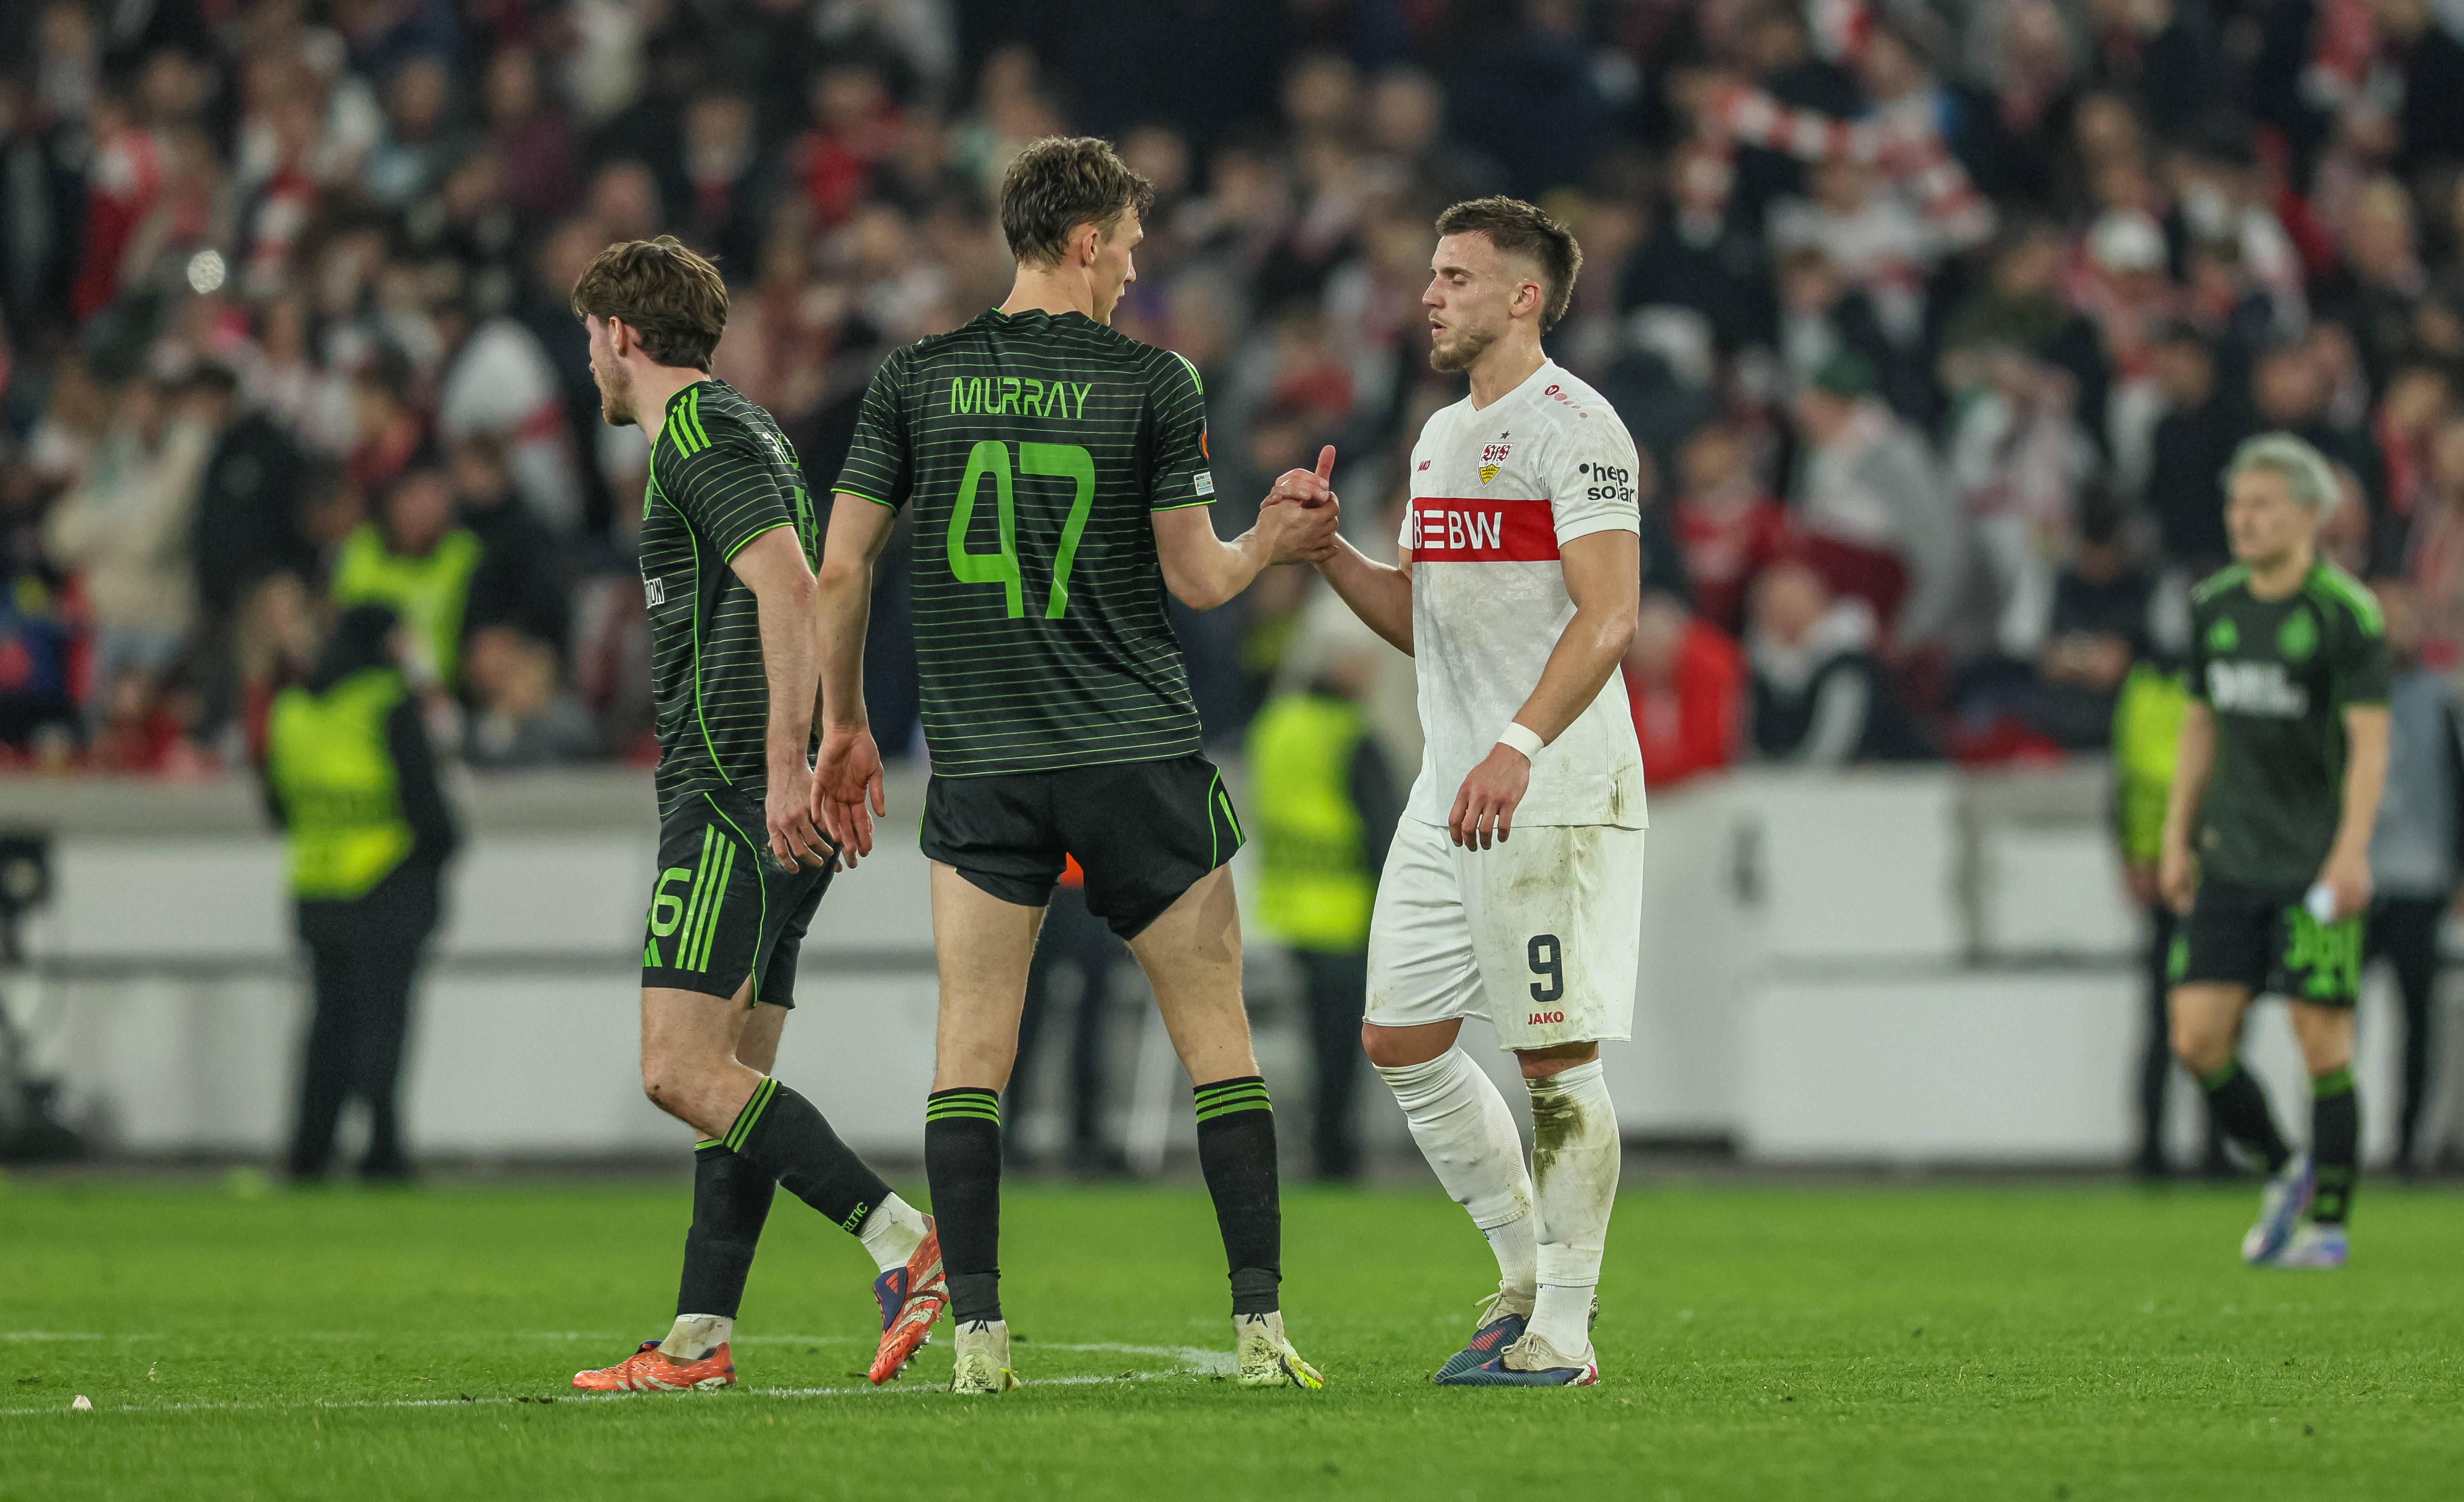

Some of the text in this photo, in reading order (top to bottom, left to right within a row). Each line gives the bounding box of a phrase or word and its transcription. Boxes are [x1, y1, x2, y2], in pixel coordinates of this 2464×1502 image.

[951, 377, 1092, 419] MURRAY
[1587, 481, 1635, 503] solar
[1592, 462, 1629, 487] hep
[947, 440, 1095, 619] 47
[646, 867, 692, 936] 6
[1527, 934, 1564, 1003] 9
[1528, 1011, 1565, 1025] JAKO
[841, 1201, 868, 1233] ELTIC
